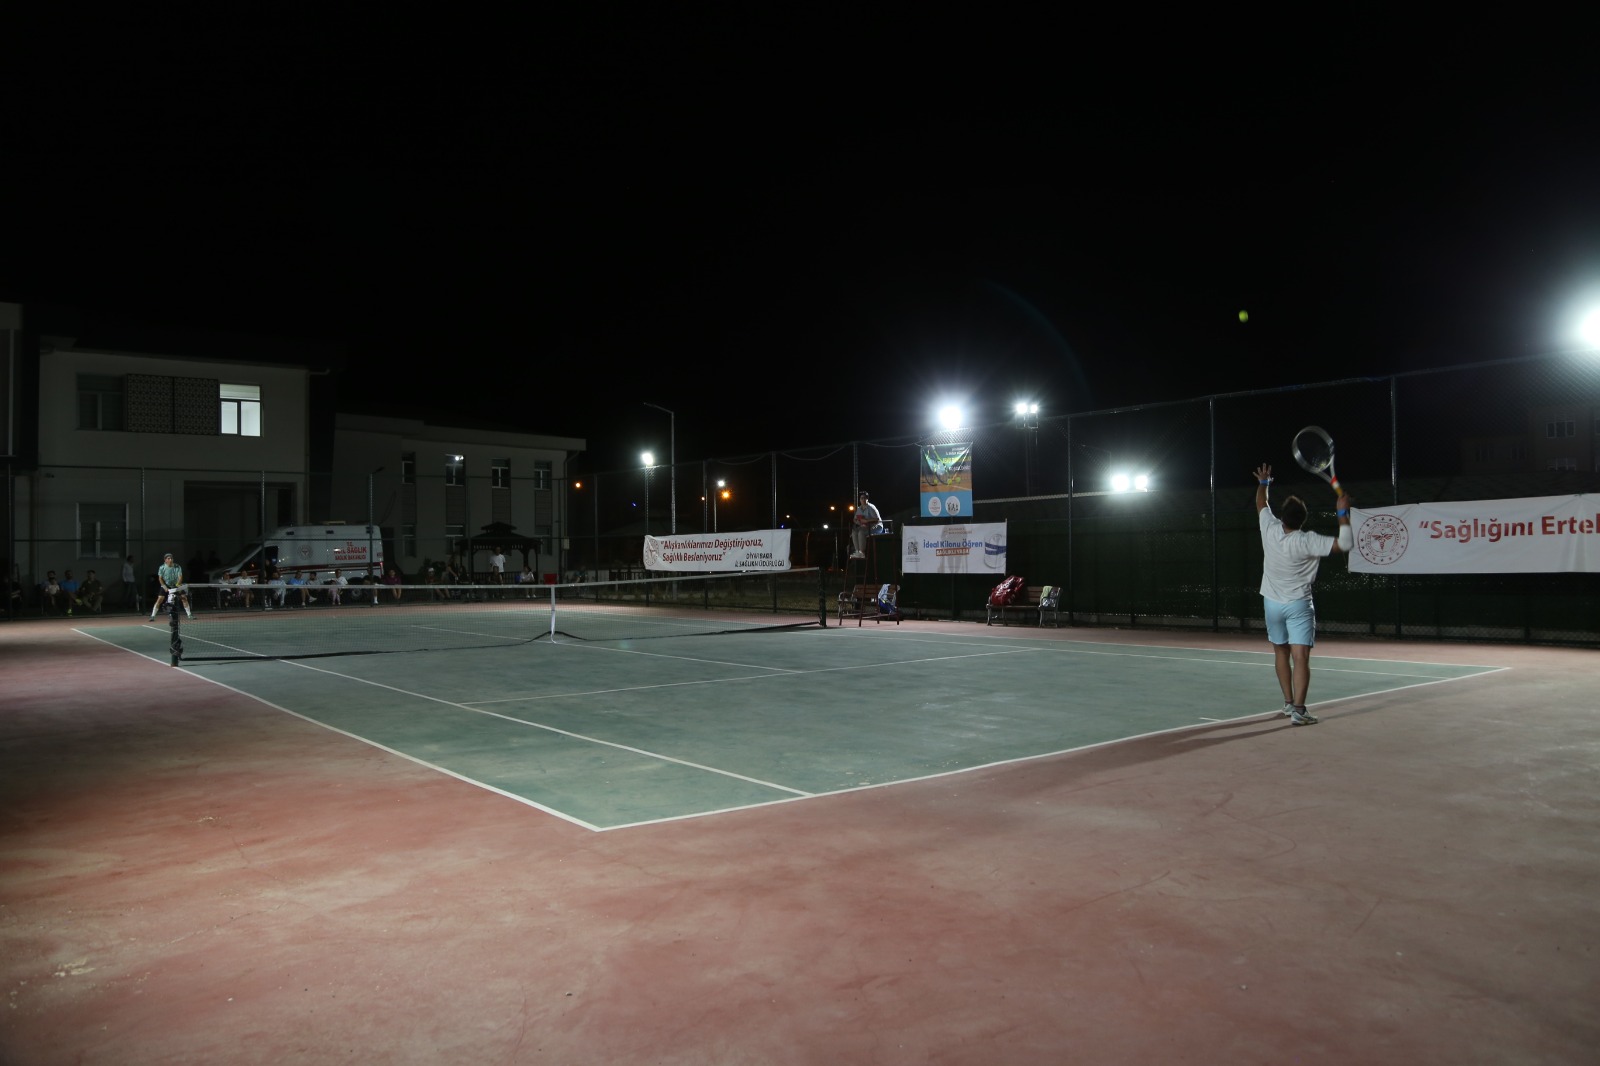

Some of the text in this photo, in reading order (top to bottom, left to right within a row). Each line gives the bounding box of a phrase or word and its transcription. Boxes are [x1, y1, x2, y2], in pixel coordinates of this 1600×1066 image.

[923, 538, 983, 549] İdeal Kilonu Öğren
